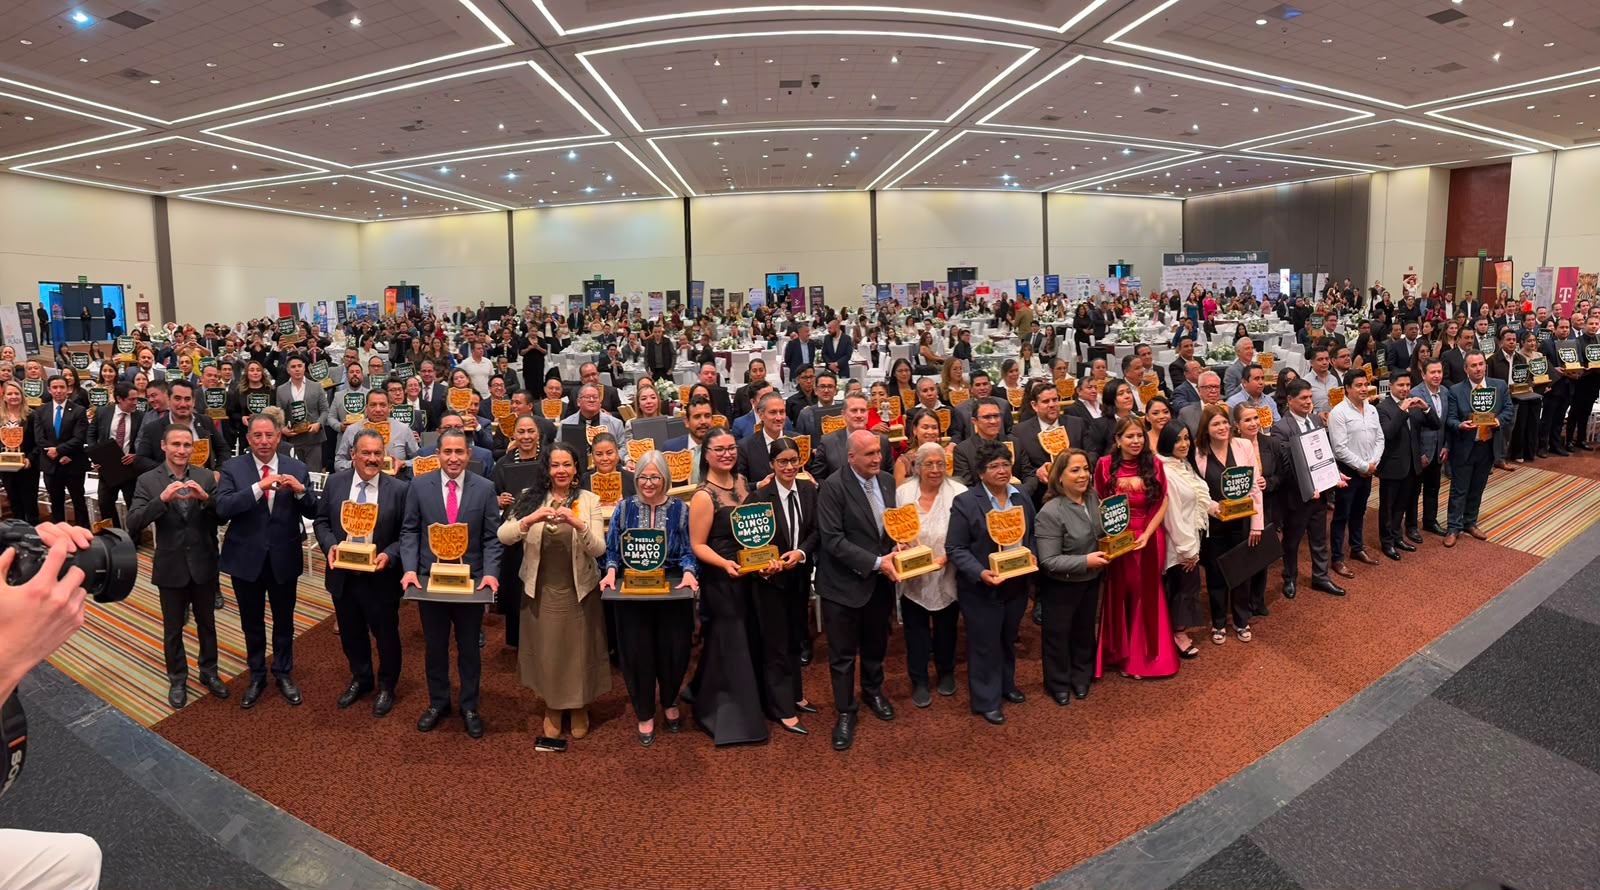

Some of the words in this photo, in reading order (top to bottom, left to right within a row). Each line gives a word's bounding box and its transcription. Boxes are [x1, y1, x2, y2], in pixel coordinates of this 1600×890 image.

[1559, 287, 1572, 303] T
[1226, 477, 1250, 487] CINCO
[1229, 482, 1250, 492] MAYO
[742, 512, 765, 520] PUEBLA
[1104, 507, 1126, 519] CINCO
[737, 516, 769, 530] CINCO
[1108, 513, 1127, 526] MAYO
[743, 524, 770, 536] MAYO
[627, 543, 660, 552] CINCO
[631, 551, 660, 559] MAYO
